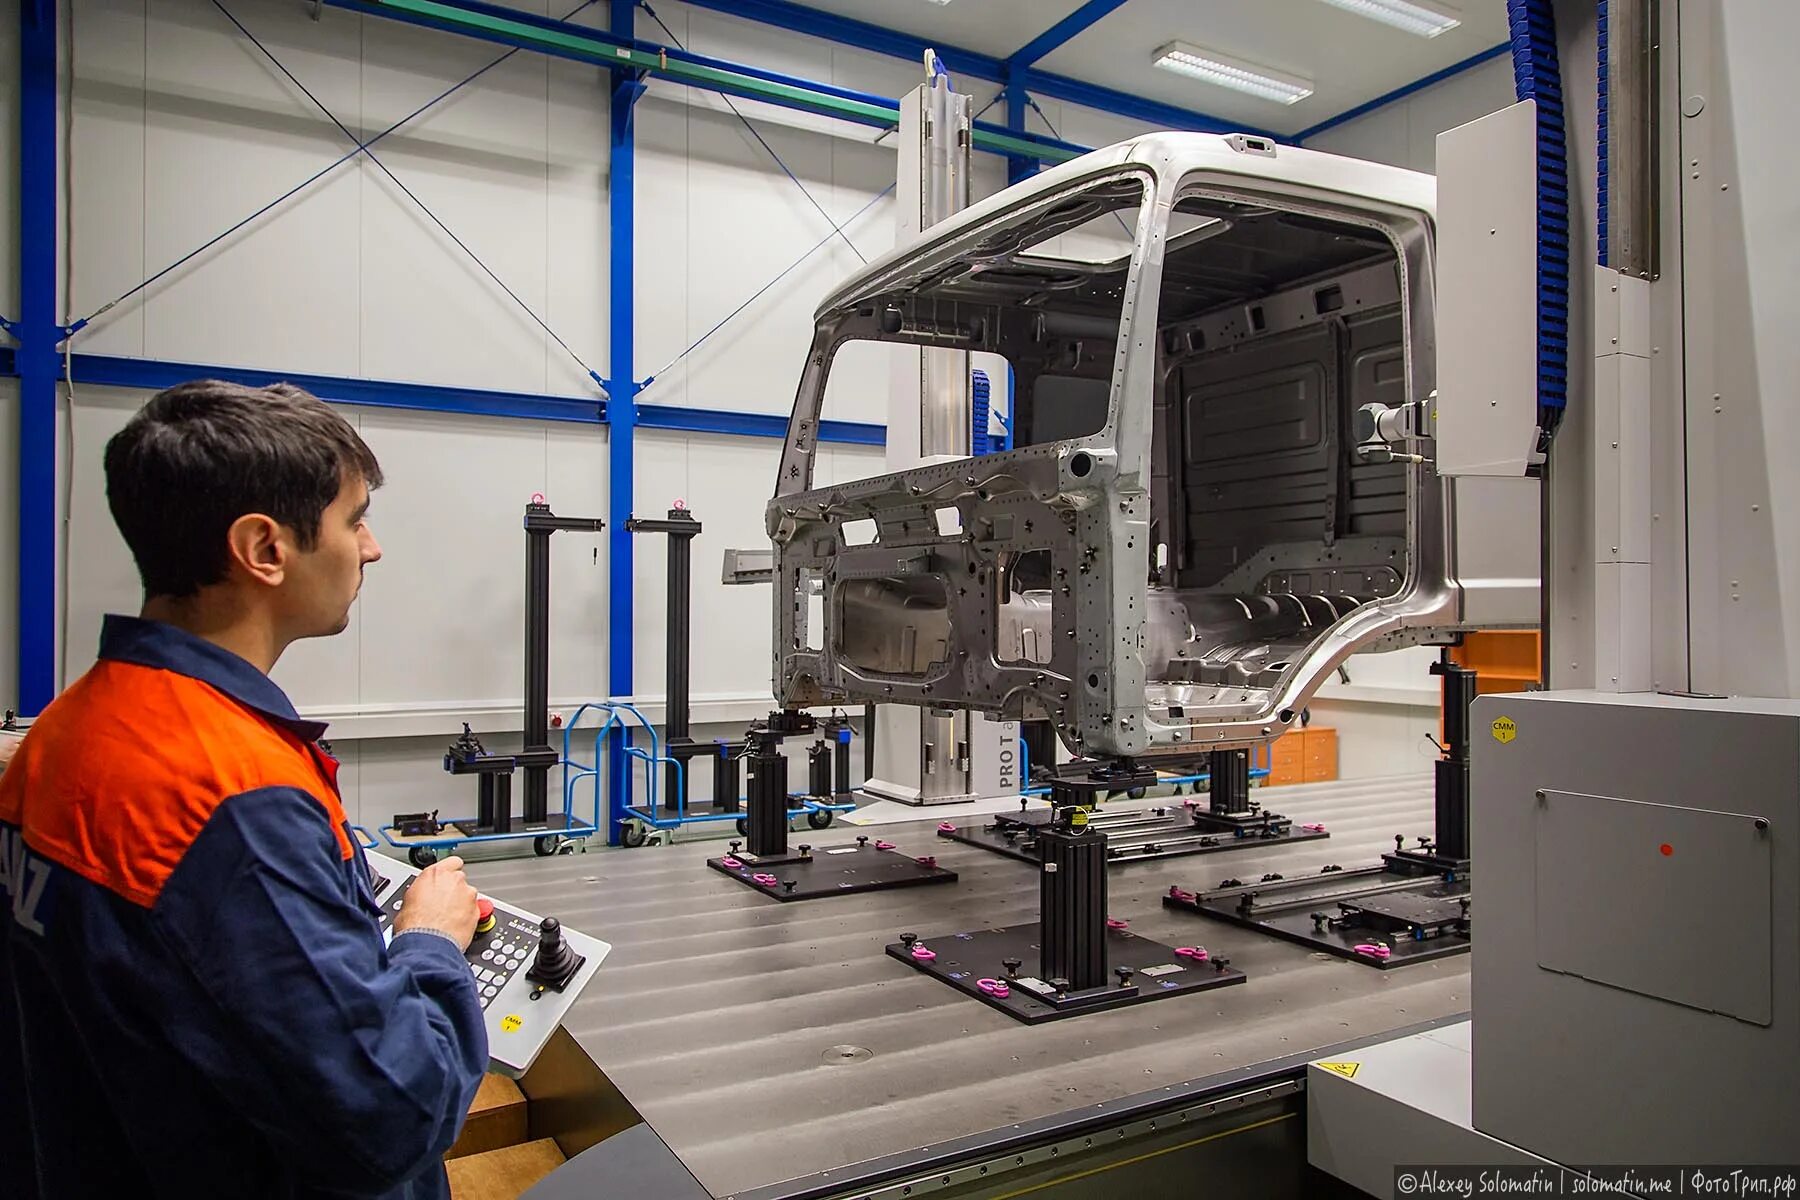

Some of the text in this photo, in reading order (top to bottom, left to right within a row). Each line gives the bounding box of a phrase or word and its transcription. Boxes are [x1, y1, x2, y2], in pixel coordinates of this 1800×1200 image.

[1493, 722, 1515, 731] CMM
[999, 750, 1013, 788] PRO
[504, 1015, 522, 1026] CMM
